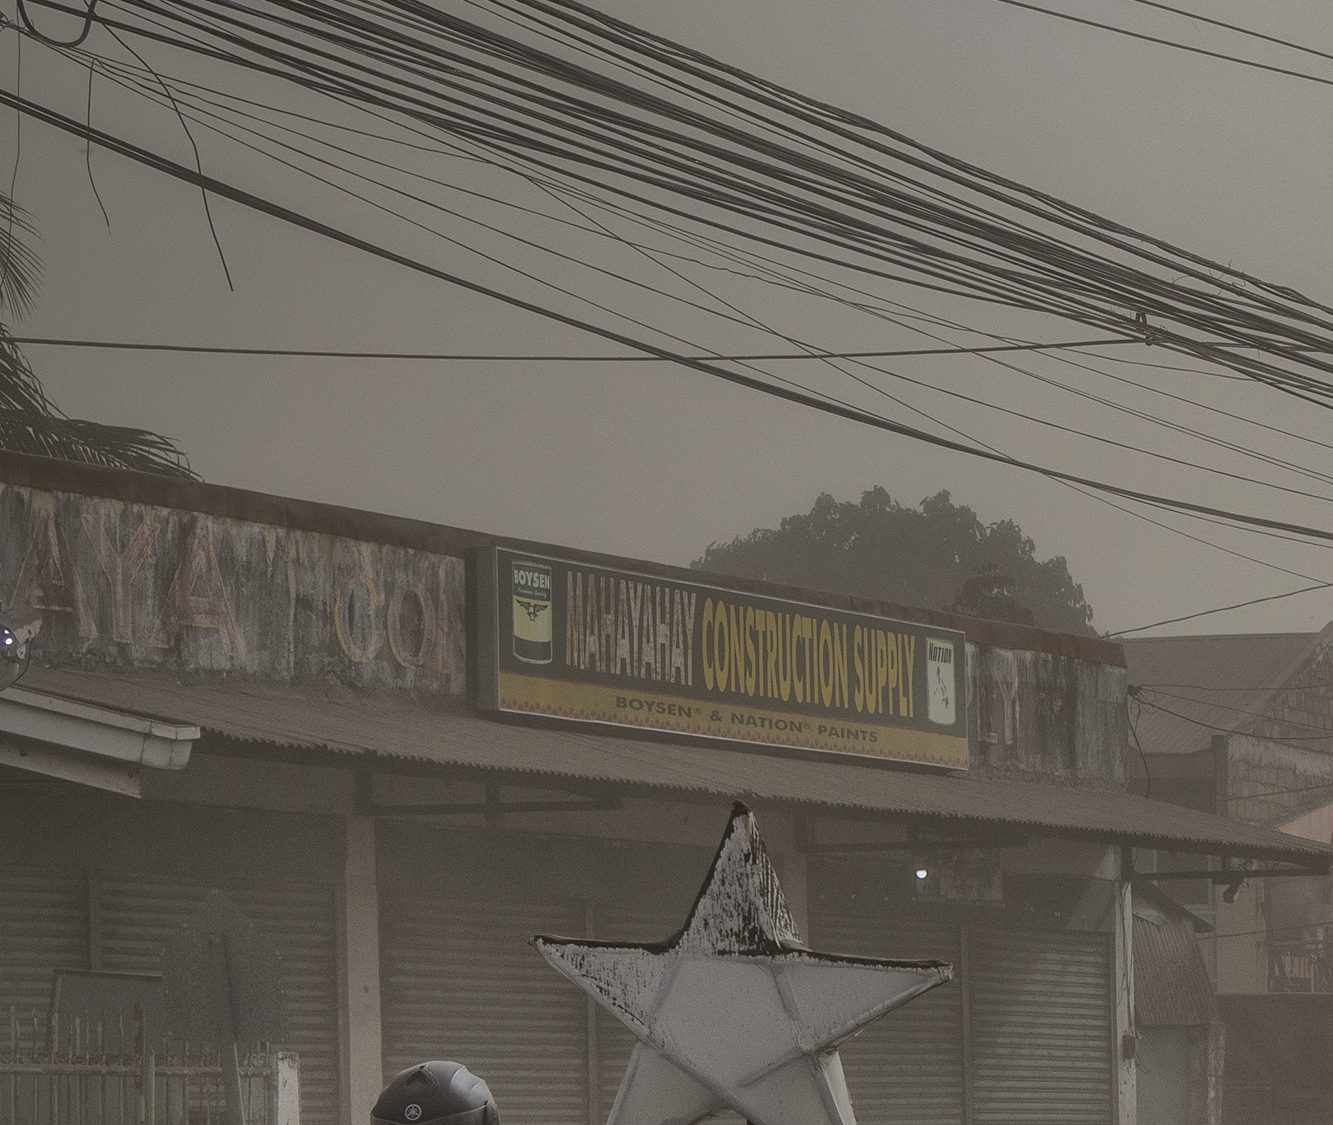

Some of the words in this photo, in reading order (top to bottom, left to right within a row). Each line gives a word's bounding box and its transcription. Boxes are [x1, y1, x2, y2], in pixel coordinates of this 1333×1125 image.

[513, 569, 550, 590] BOYSEN
[565, 570, 697, 686] MAHAYAHAY
[702, 597, 849, 709] CONSTRUCTION
[854, 623, 916, 718] SUPPLY
[709, 710, 723, 722] &
[817, 724, 878, 742] PAINTS
